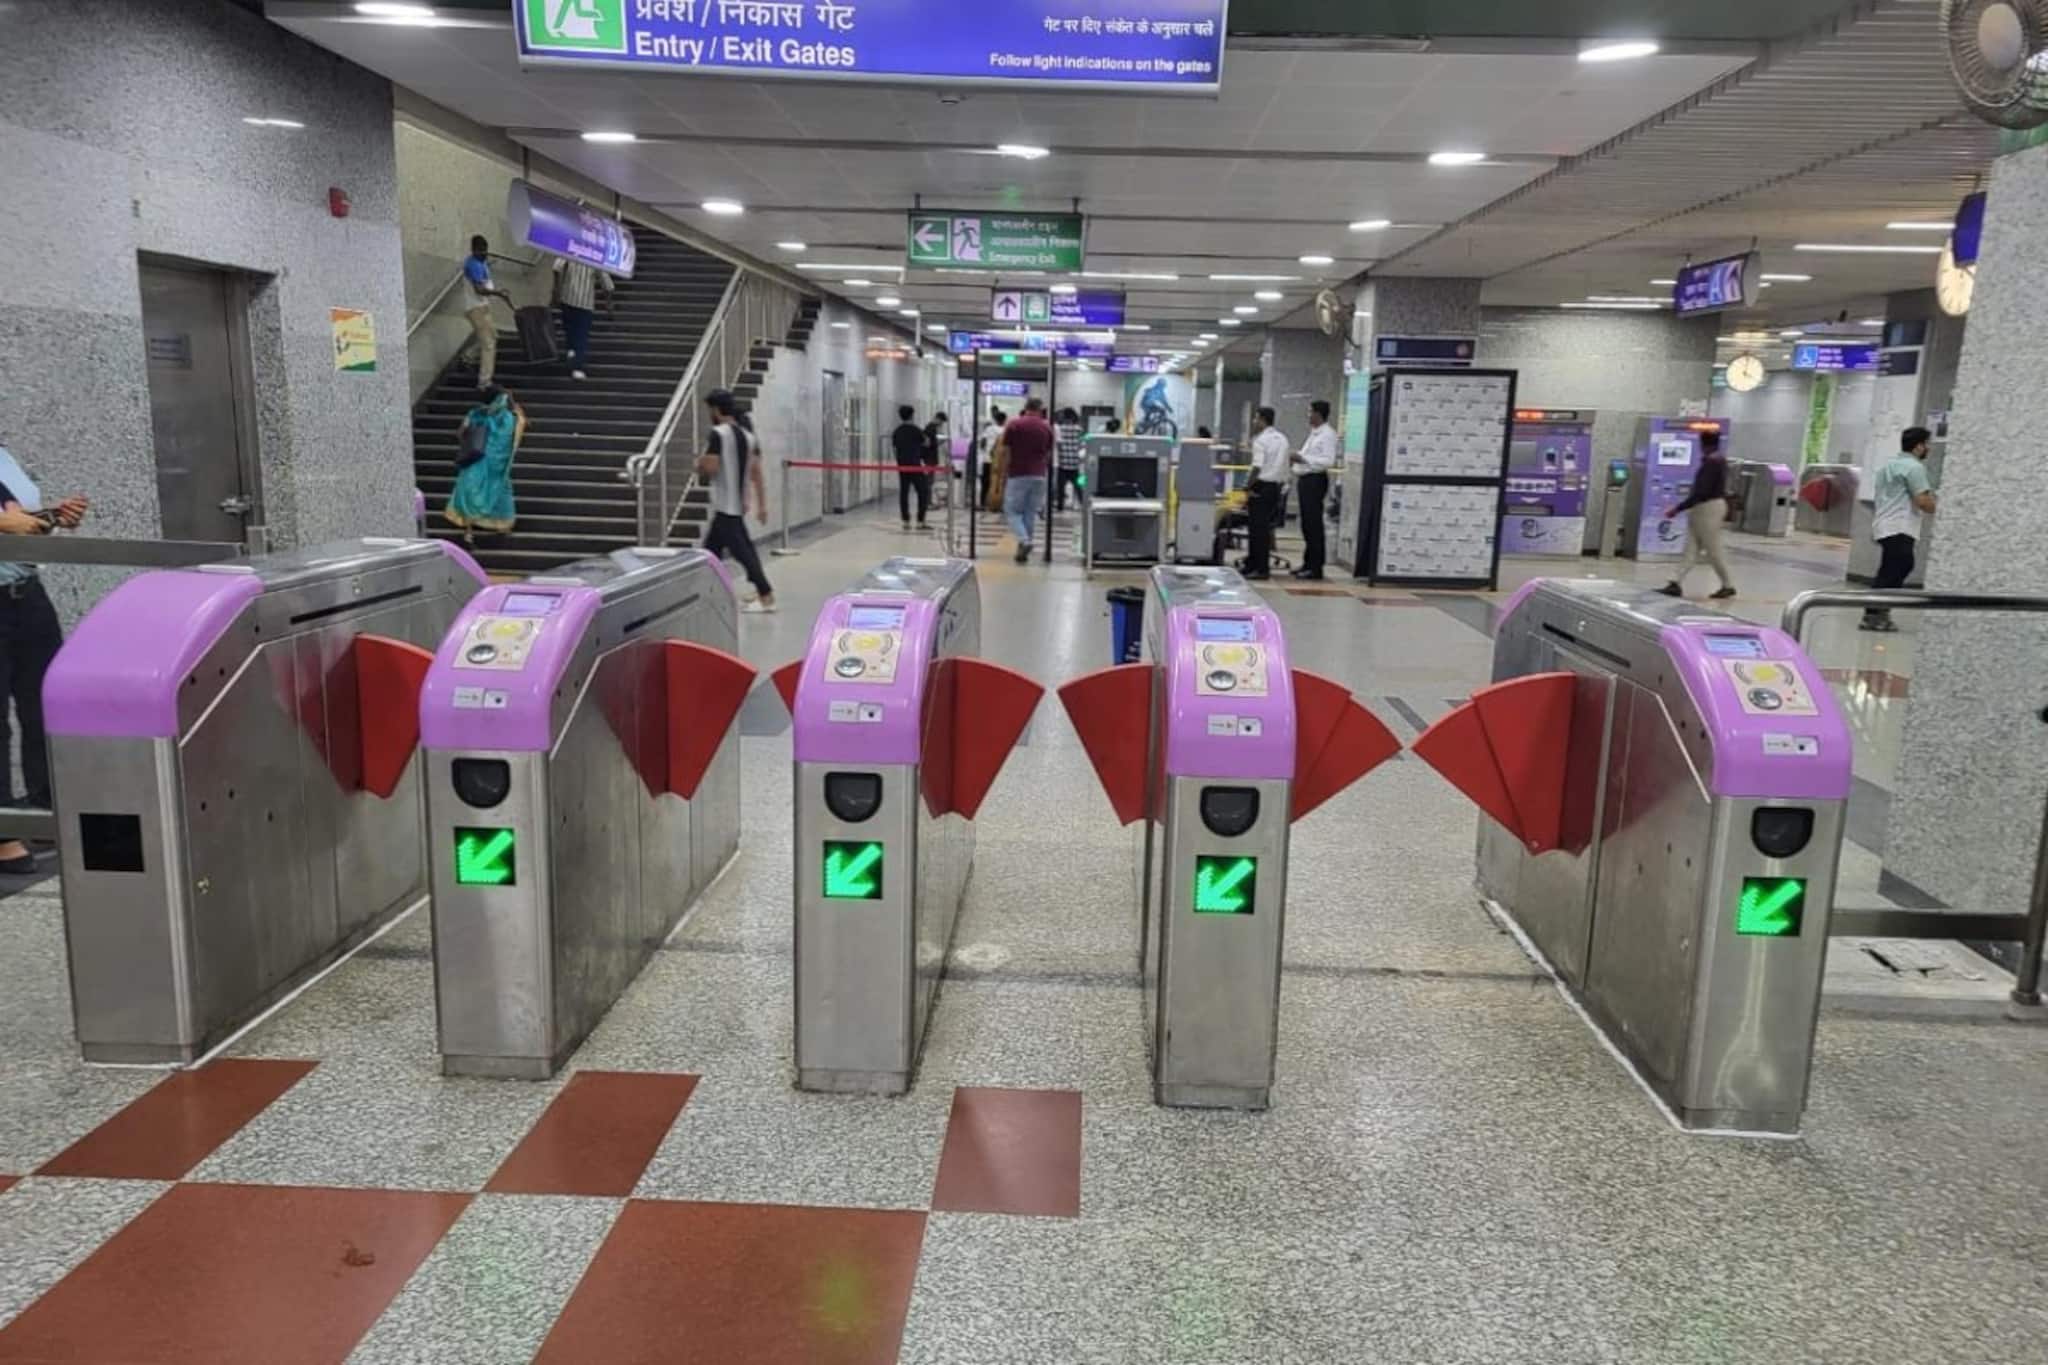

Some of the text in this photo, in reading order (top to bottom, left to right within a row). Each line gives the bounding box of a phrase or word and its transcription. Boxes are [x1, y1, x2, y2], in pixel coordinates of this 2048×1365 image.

[635, 31, 704, 64] Entry
[723, 36, 773, 62] Exit
[780, 38, 856, 66] Gates
[990, 53, 1212, 75] Follow light indications on the gates
